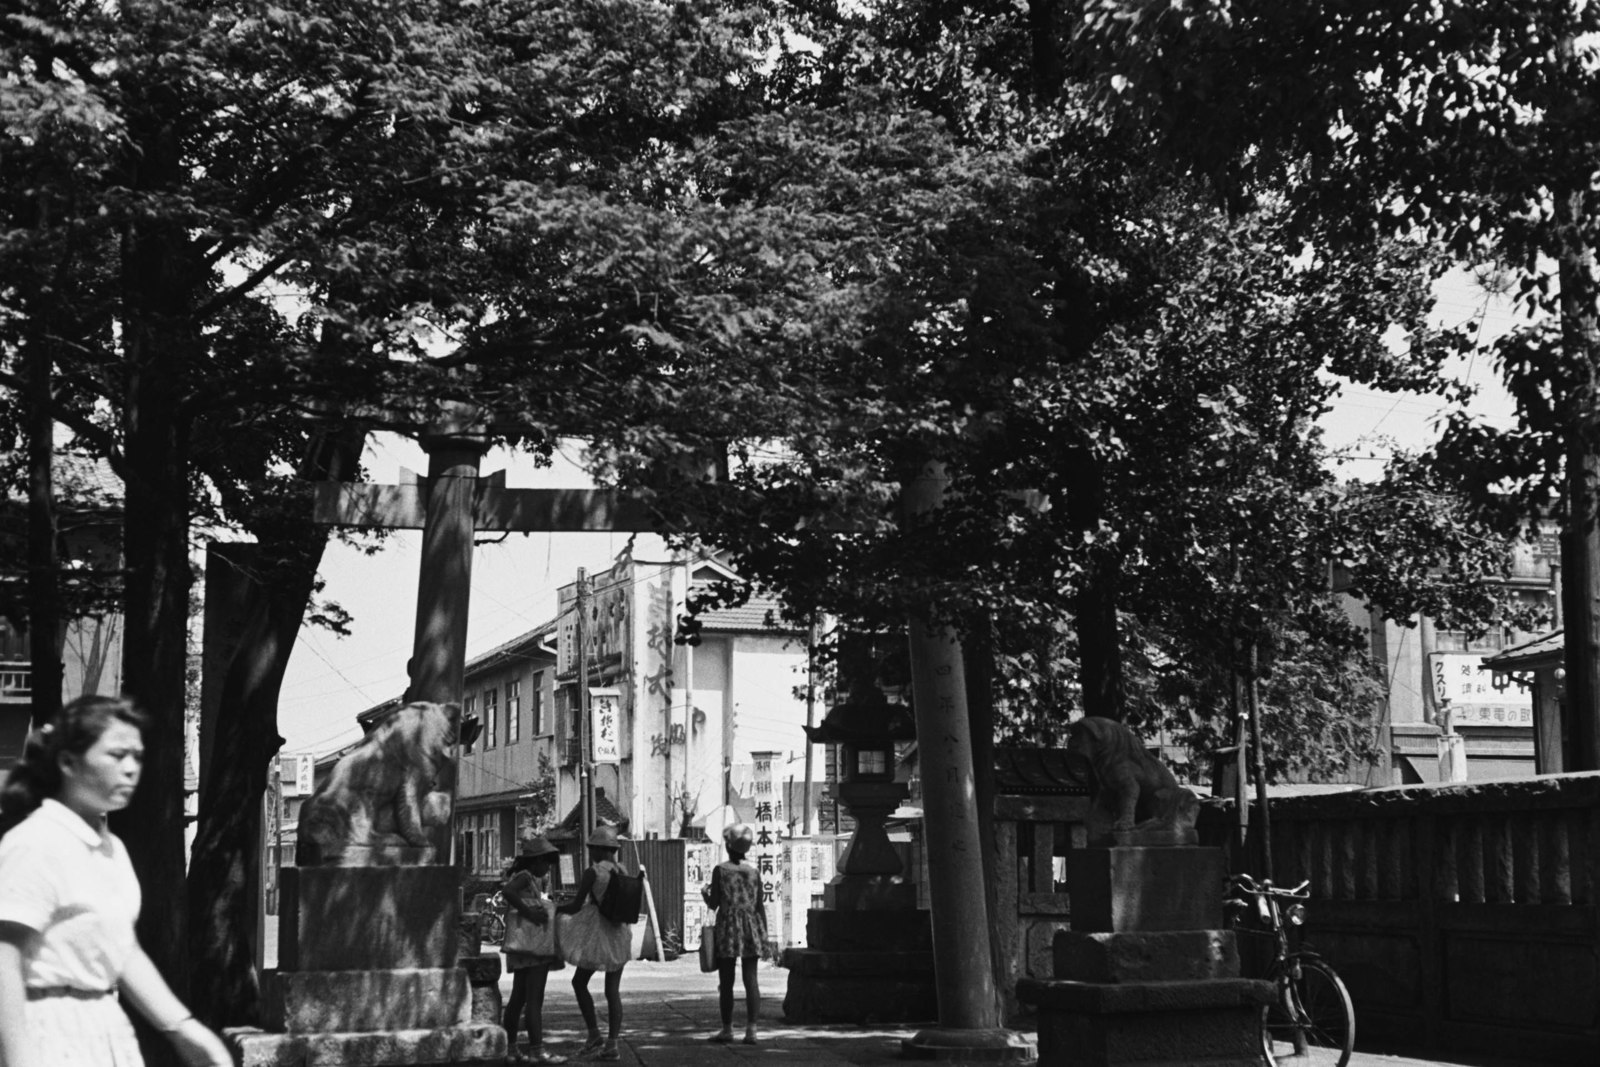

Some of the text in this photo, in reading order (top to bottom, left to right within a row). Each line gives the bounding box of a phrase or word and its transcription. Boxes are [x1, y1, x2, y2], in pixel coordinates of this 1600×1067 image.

[1435, 661, 1447, 698] クスリ
[755, 801, 775, 903] 橋本病院
